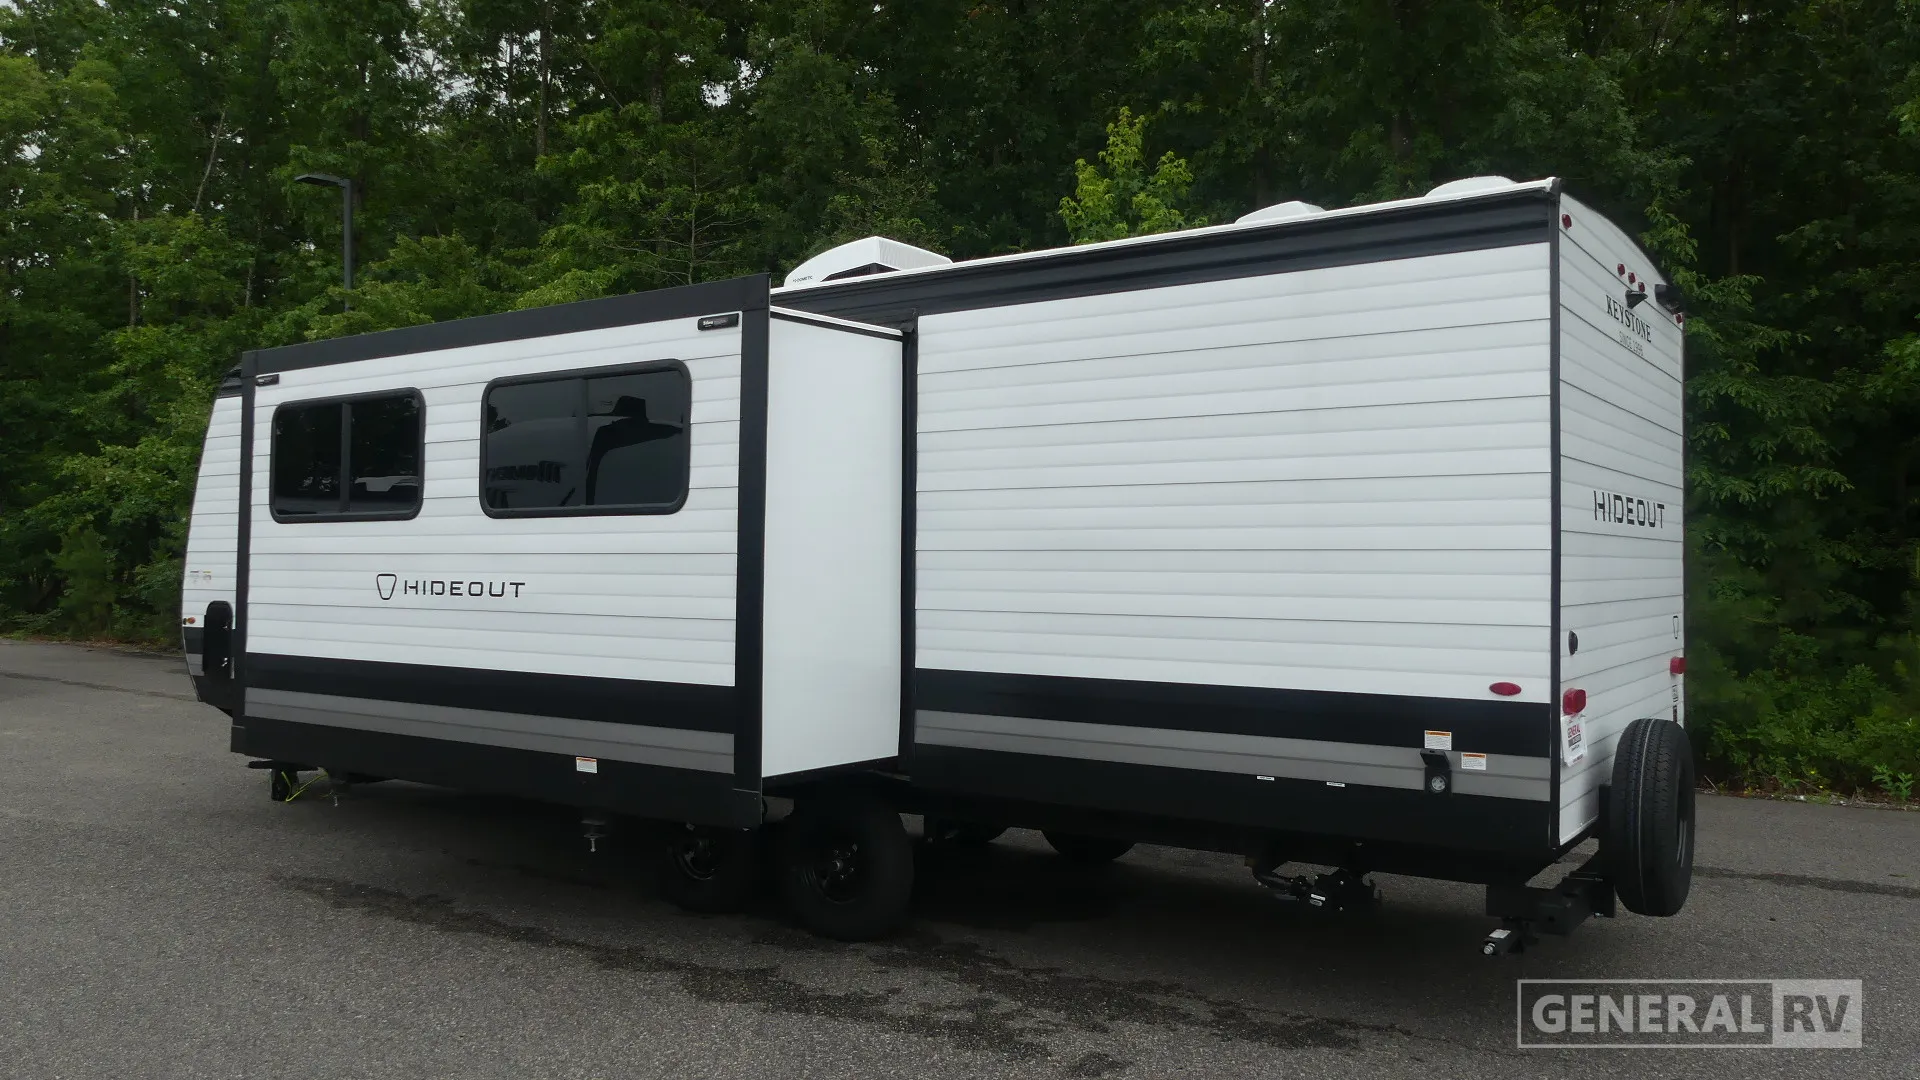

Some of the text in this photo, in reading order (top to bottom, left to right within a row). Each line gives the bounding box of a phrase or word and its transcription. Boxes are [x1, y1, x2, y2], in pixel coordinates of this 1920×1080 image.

[1606, 294, 1651, 343] KEYSTONE
[1593, 490, 1665, 529] HIDEOUT
[404, 580, 526, 598] HIDEOUT
